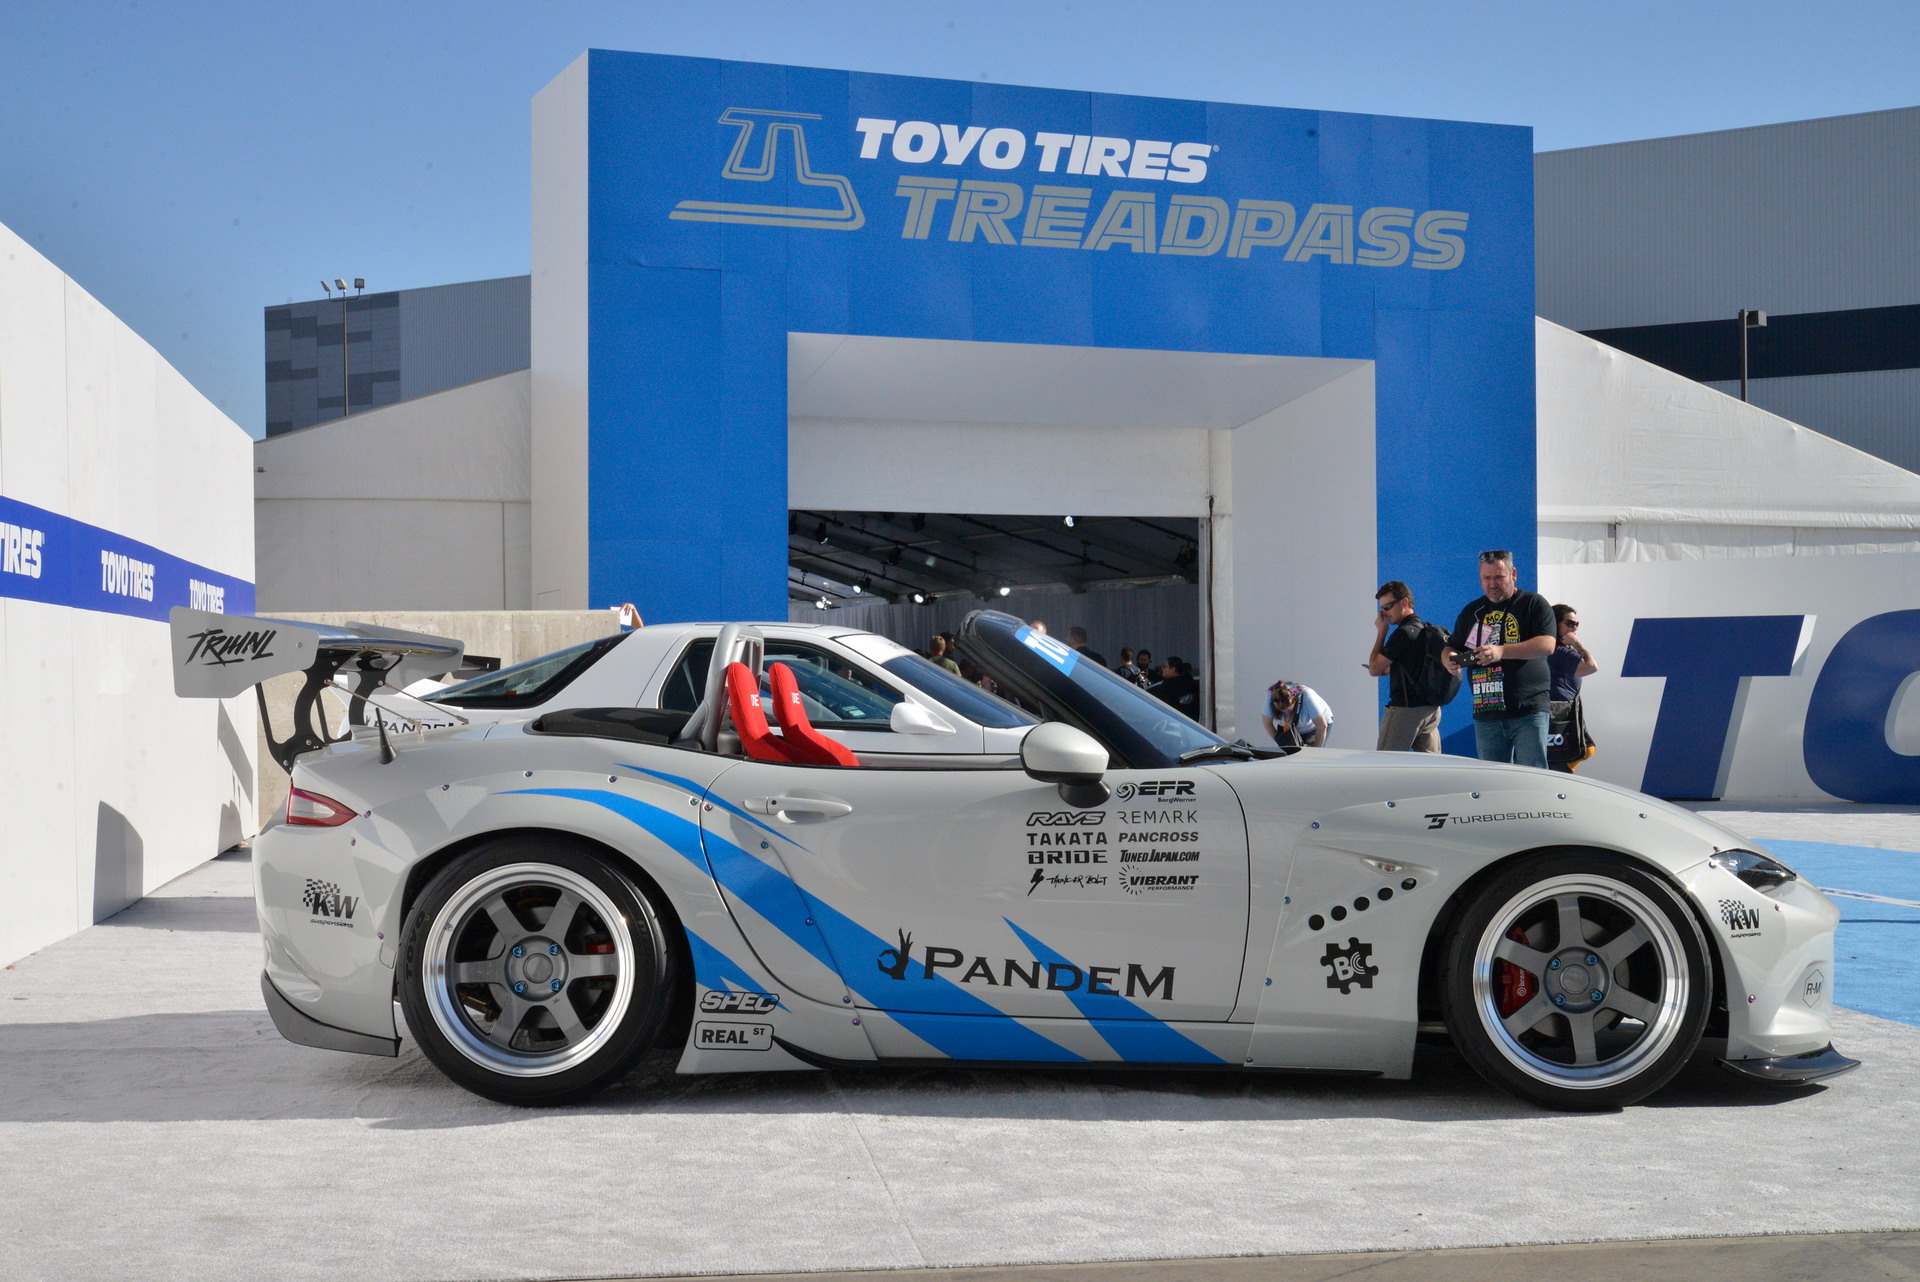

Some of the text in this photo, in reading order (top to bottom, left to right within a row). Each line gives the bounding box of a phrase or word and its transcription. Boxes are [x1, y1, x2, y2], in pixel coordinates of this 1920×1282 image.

[855, 117, 1213, 184] TOYO TIRES
[894, 174, 1470, 270] TREADPASS
[101, 549, 154, 602] TOYO TIRES
[189, 578, 224, 615] TOYO TIRES
[1620, 609, 1920, 805] TO
[1138, 780, 1196, 796] EFR
[1026, 811, 1107, 827] RAYS
[1117, 810, 1199, 824] REMARK
[1450, 811, 1575, 825] TURBOSOURCE
[1026, 831, 1108, 846] TAKATA
[1118, 831, 1199, 843] PANCROSS
[1027, 849, 1108, 865] BRIDE
[1130, 875, 1200, 886] VIBRANT
[311, 892, 360, 920] KW
[1728, 908, 1761, 931] KW
[923, 944, 1177, 1001] PANDEM
[699, 990, 781, 1015] SPEC
[701, 1027, 766, 1045] REAL ST
